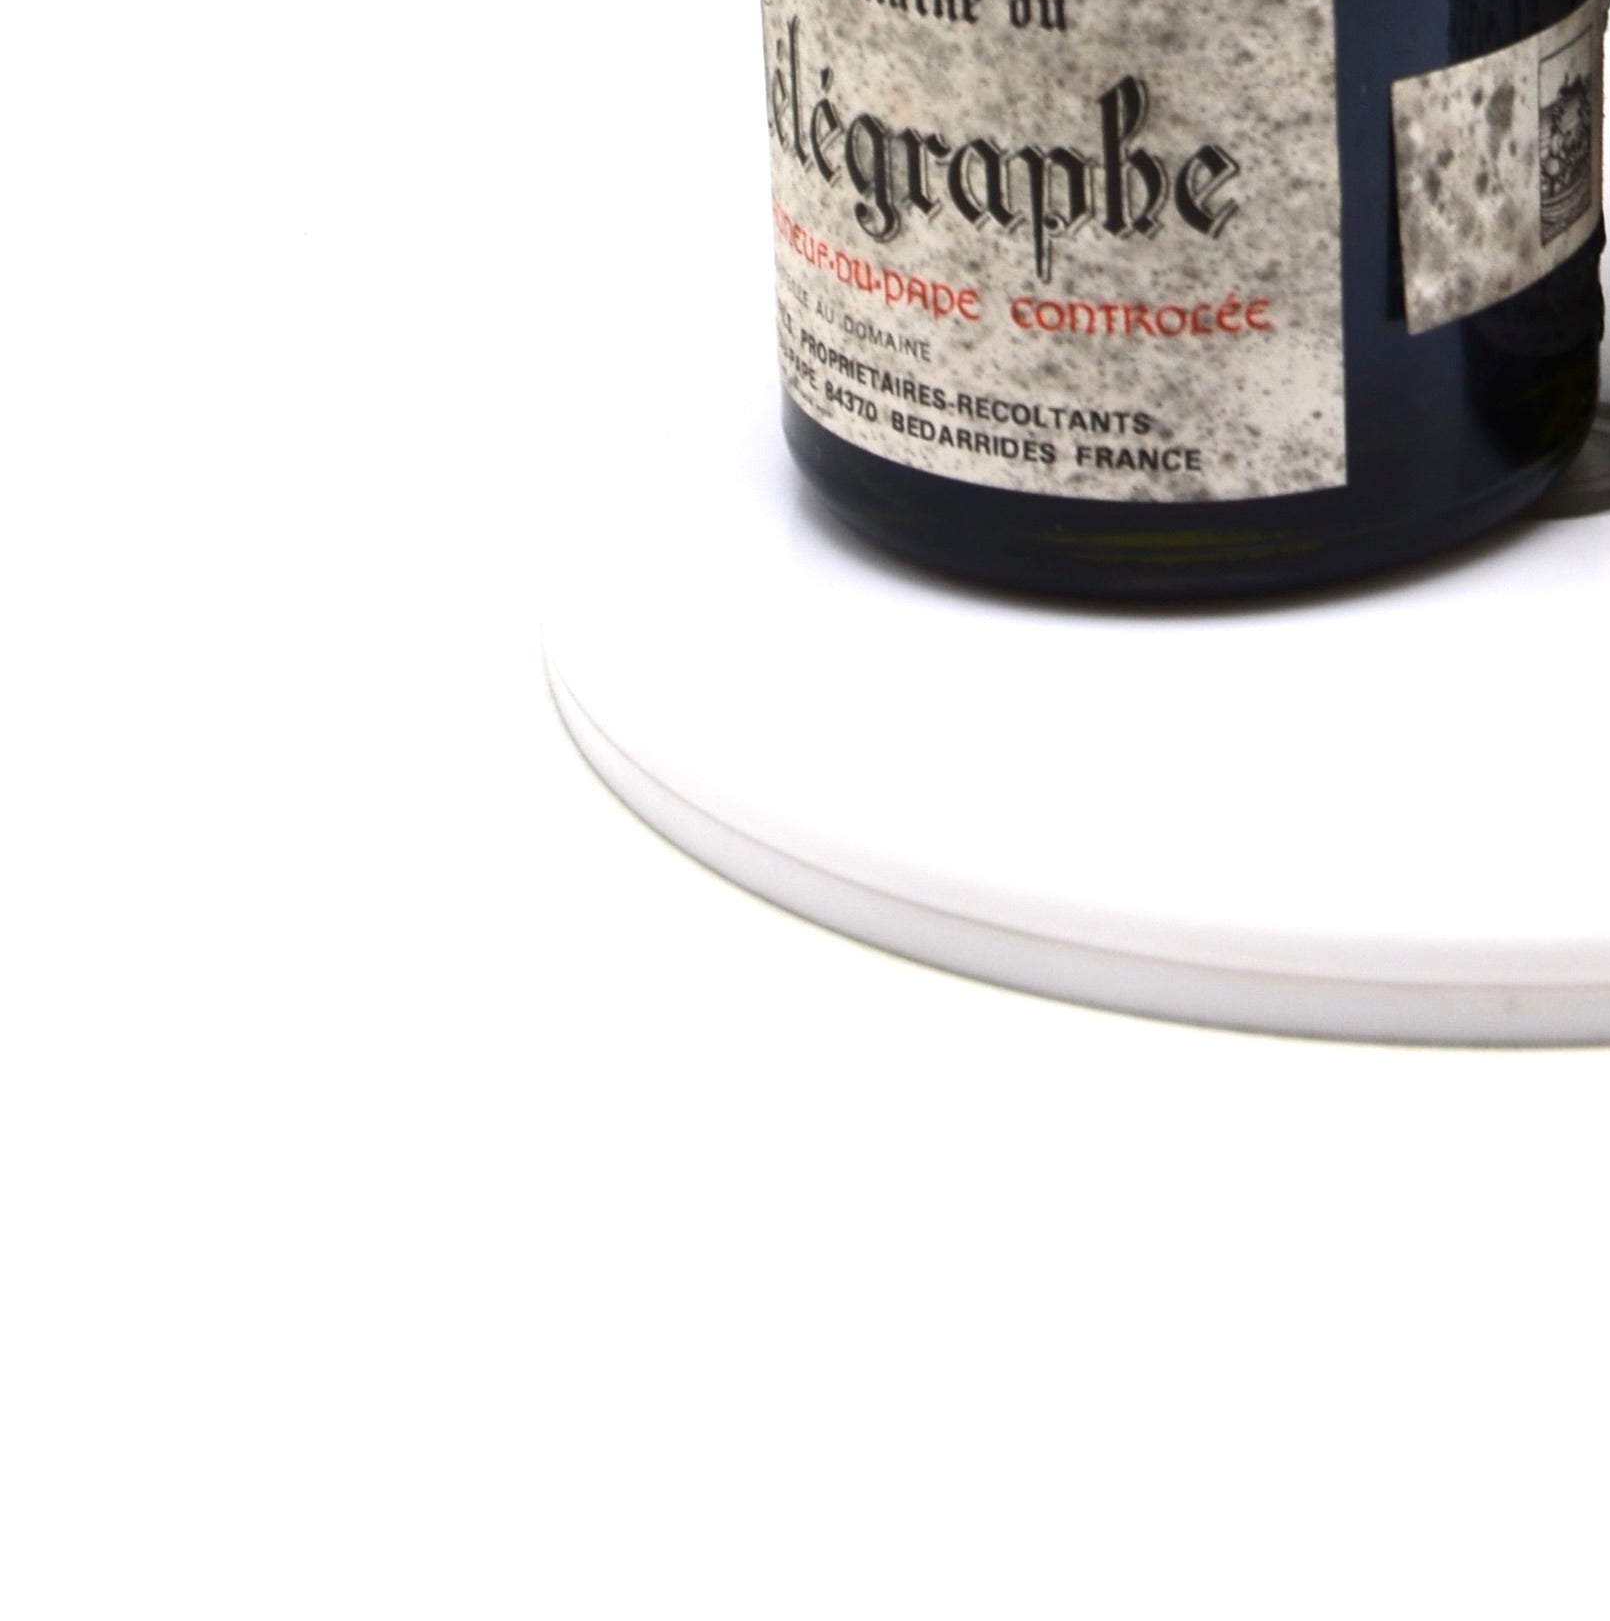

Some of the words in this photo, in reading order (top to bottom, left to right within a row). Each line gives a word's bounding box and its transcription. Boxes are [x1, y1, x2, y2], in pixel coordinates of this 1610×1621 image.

[815, 301, 836, 326] AU
[843, 313, 932, 362] DOMAINE
[800, 328, 1152, 436] PROPRIETAIRES-RECOLTANTS
[824, 380, 878, 423] 84370
[891, 409, 1057, 466] BEDARRIDES
[1076, 444, 1202, 472] FRANCE
